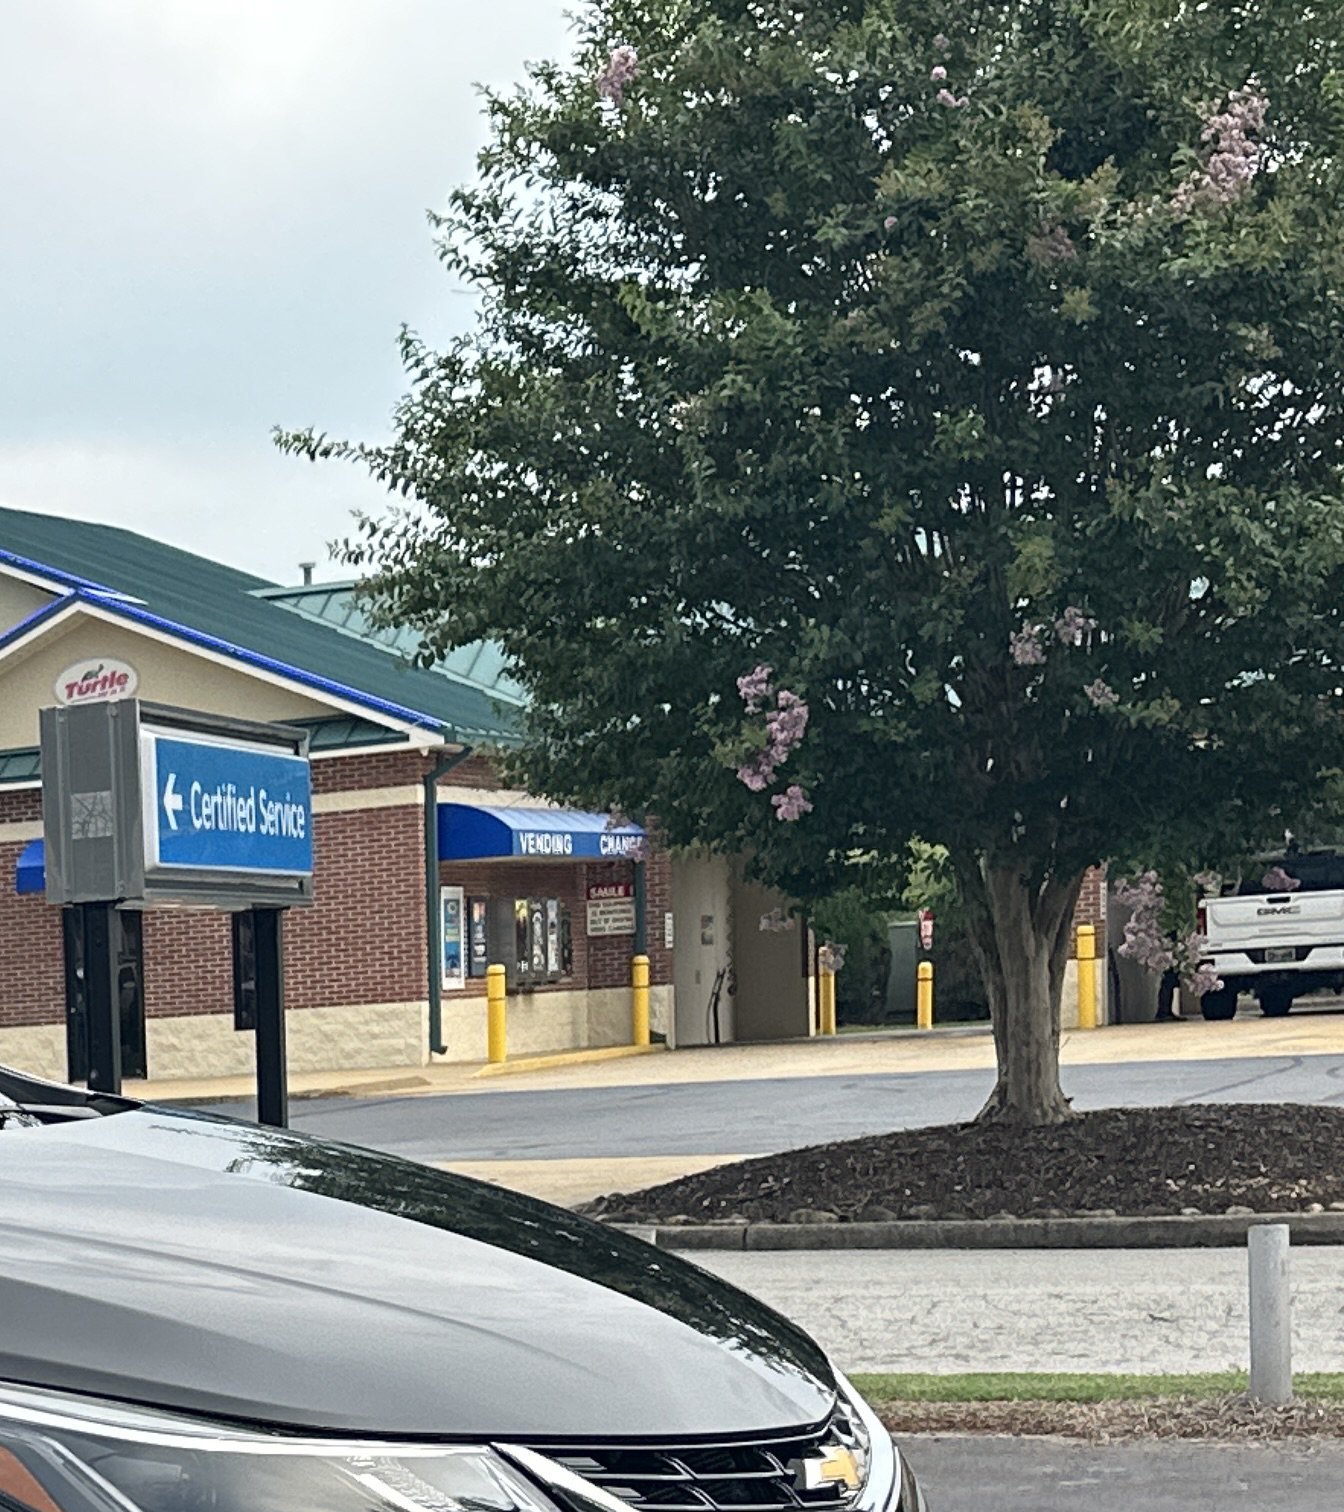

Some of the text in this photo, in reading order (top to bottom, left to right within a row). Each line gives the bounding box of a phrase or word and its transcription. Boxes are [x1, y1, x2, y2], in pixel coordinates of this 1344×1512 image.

[64, 670, 130, 700] Turtle
[190, 780, 306, 840] Certified Service
[519, 832, 573, 855] VENDING
[1256, 905, 1301, 916] GMC
